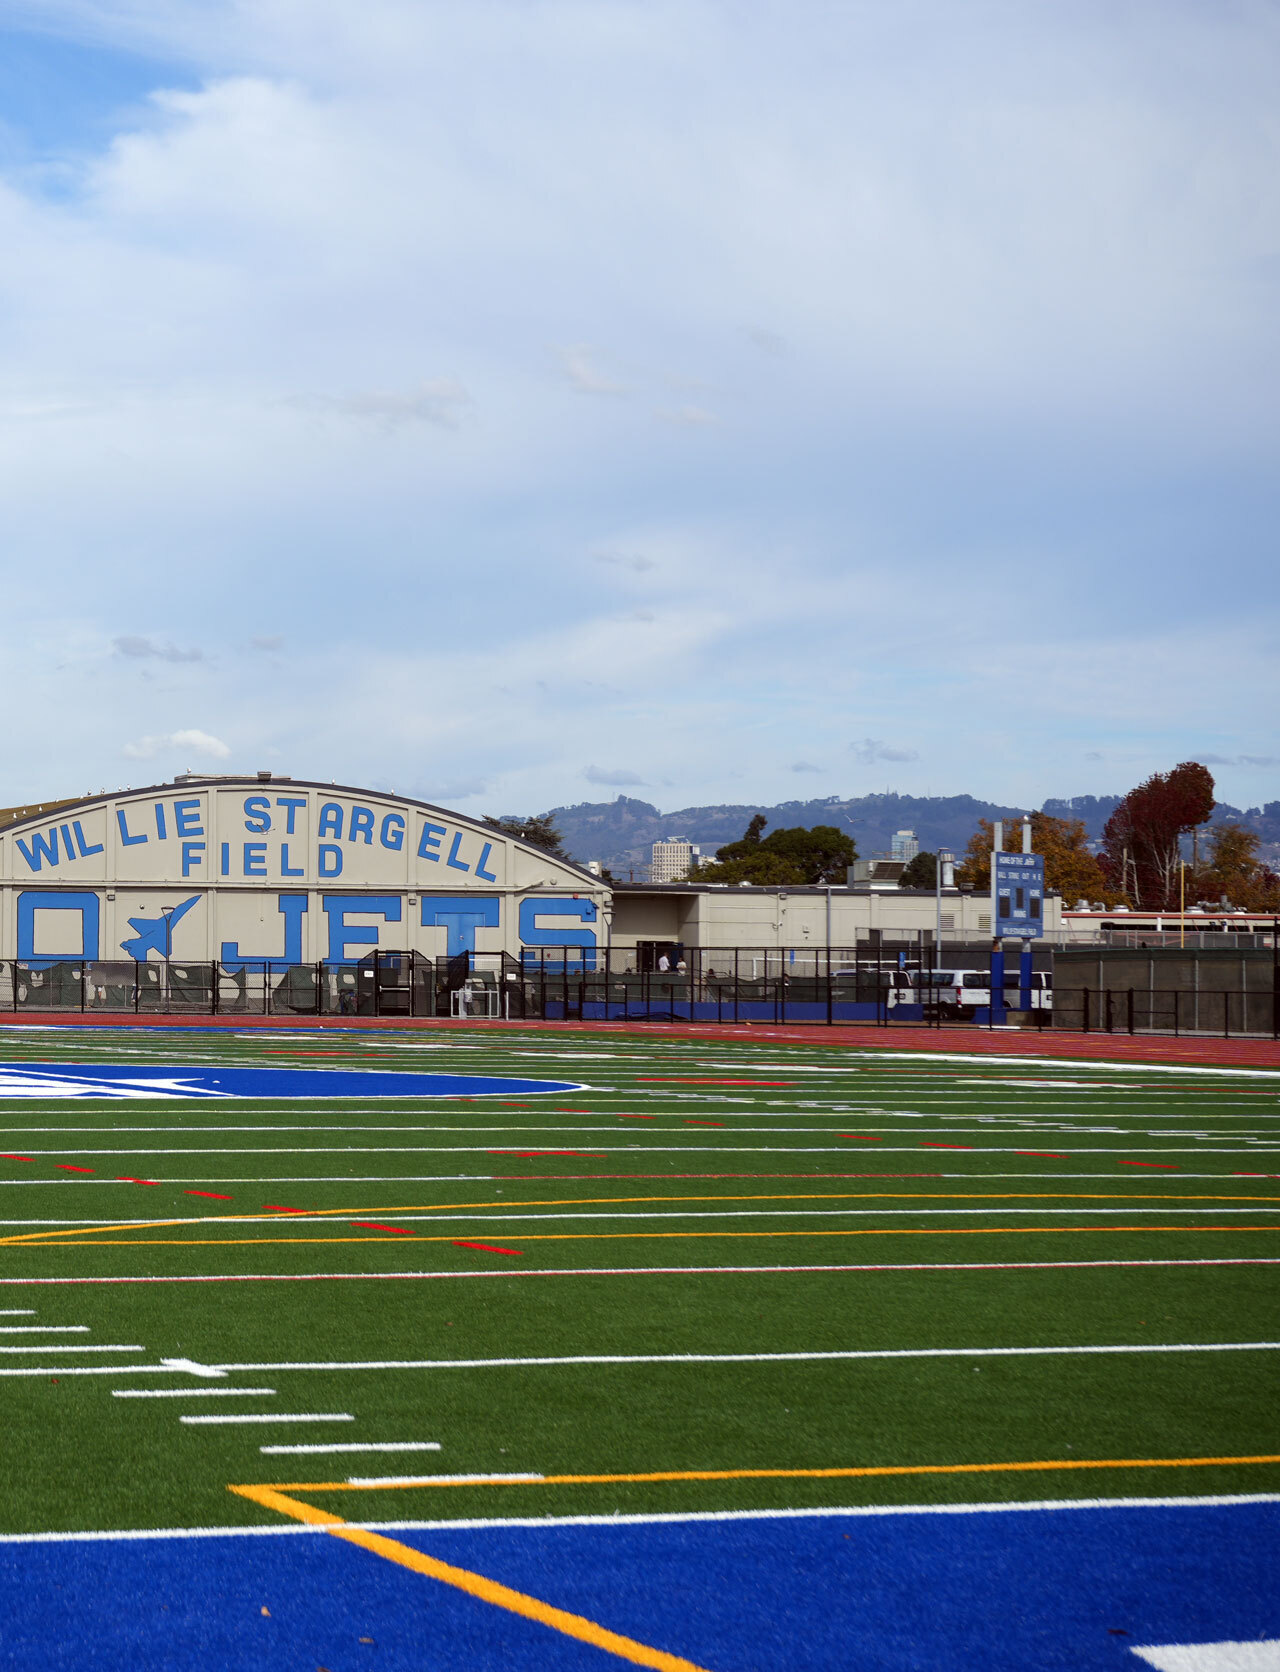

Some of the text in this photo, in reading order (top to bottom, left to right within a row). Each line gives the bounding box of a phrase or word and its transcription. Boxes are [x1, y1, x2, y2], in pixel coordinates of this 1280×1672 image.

[15, 796, 497, 883] WILLIE STARGELL
[181, 842, 343, 878] FIELD
[221, 895, 597, 973] JETS
